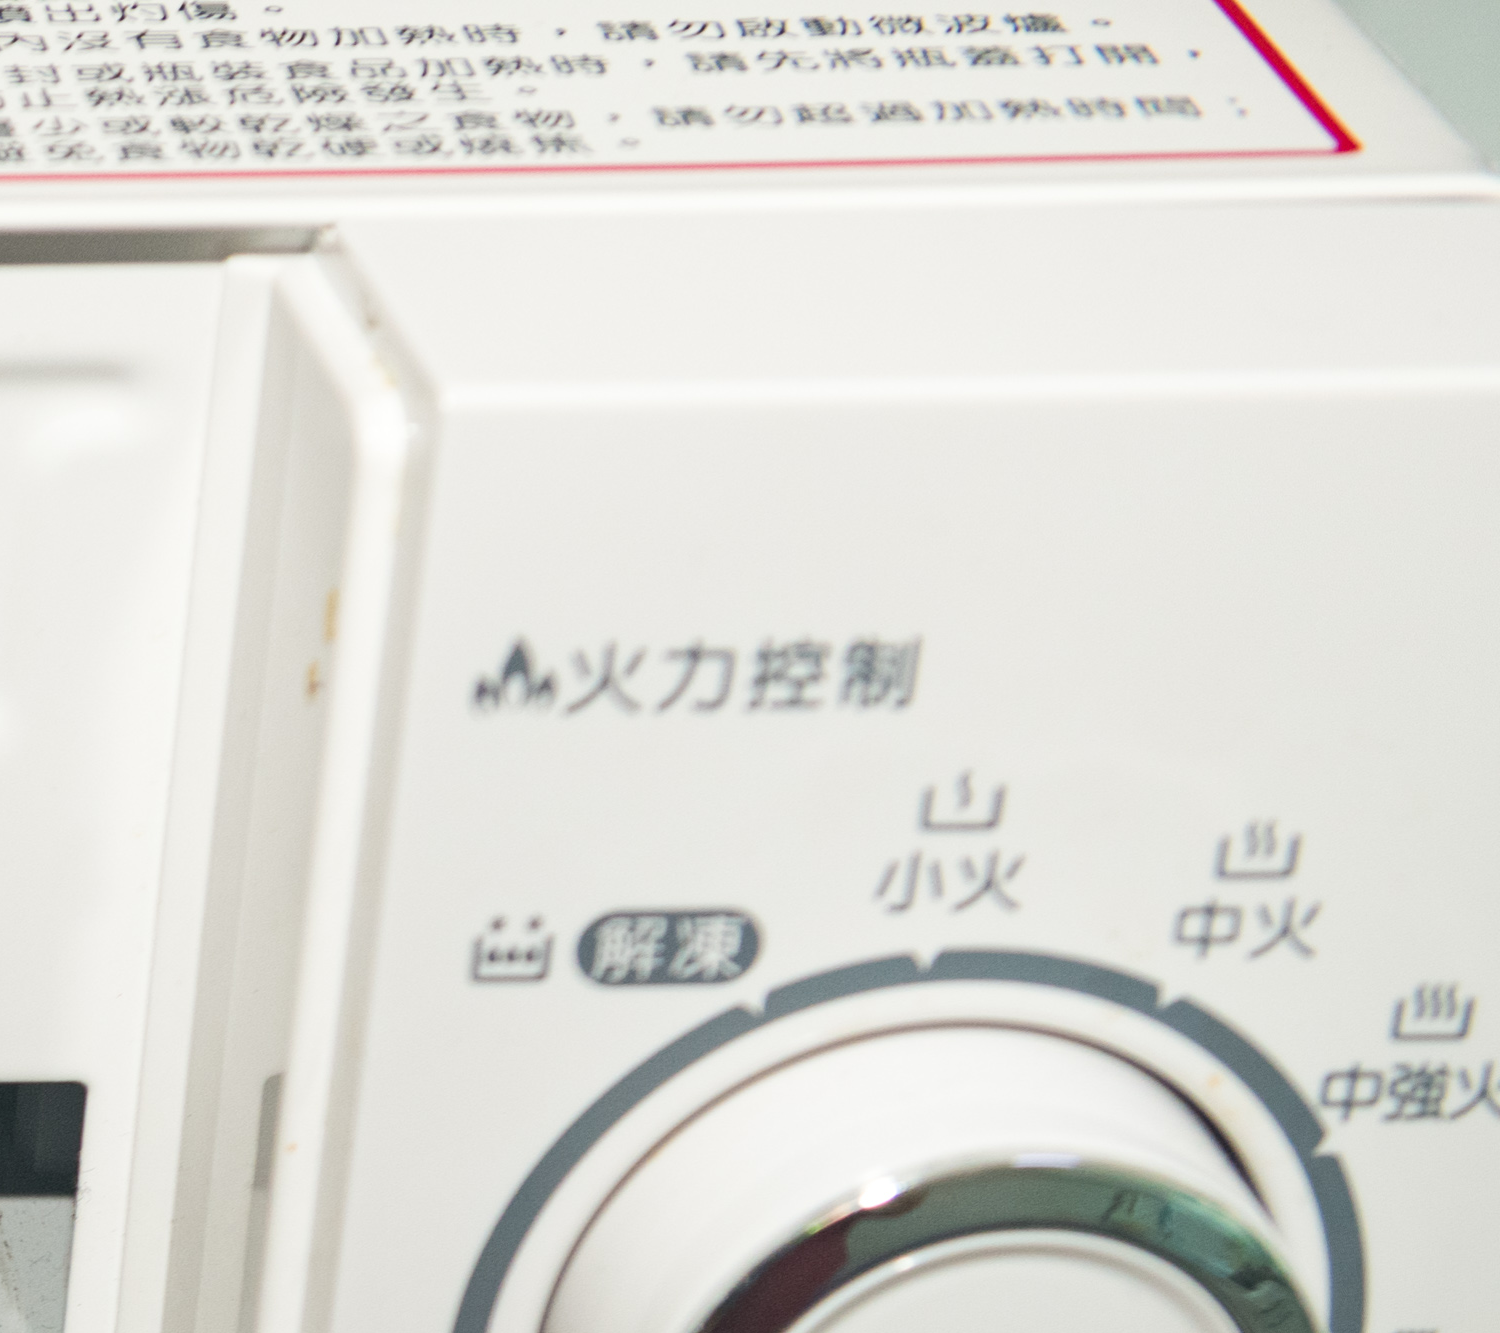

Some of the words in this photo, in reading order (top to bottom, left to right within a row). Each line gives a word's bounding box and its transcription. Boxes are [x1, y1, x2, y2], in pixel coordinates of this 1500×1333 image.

[560, 638, 923, 718] 火力控制
[873, 849, 1029, 916] 小火
[1172, 896, 1323, 963] 中火
[1319, 1060, 1500, 1123] 中強火
